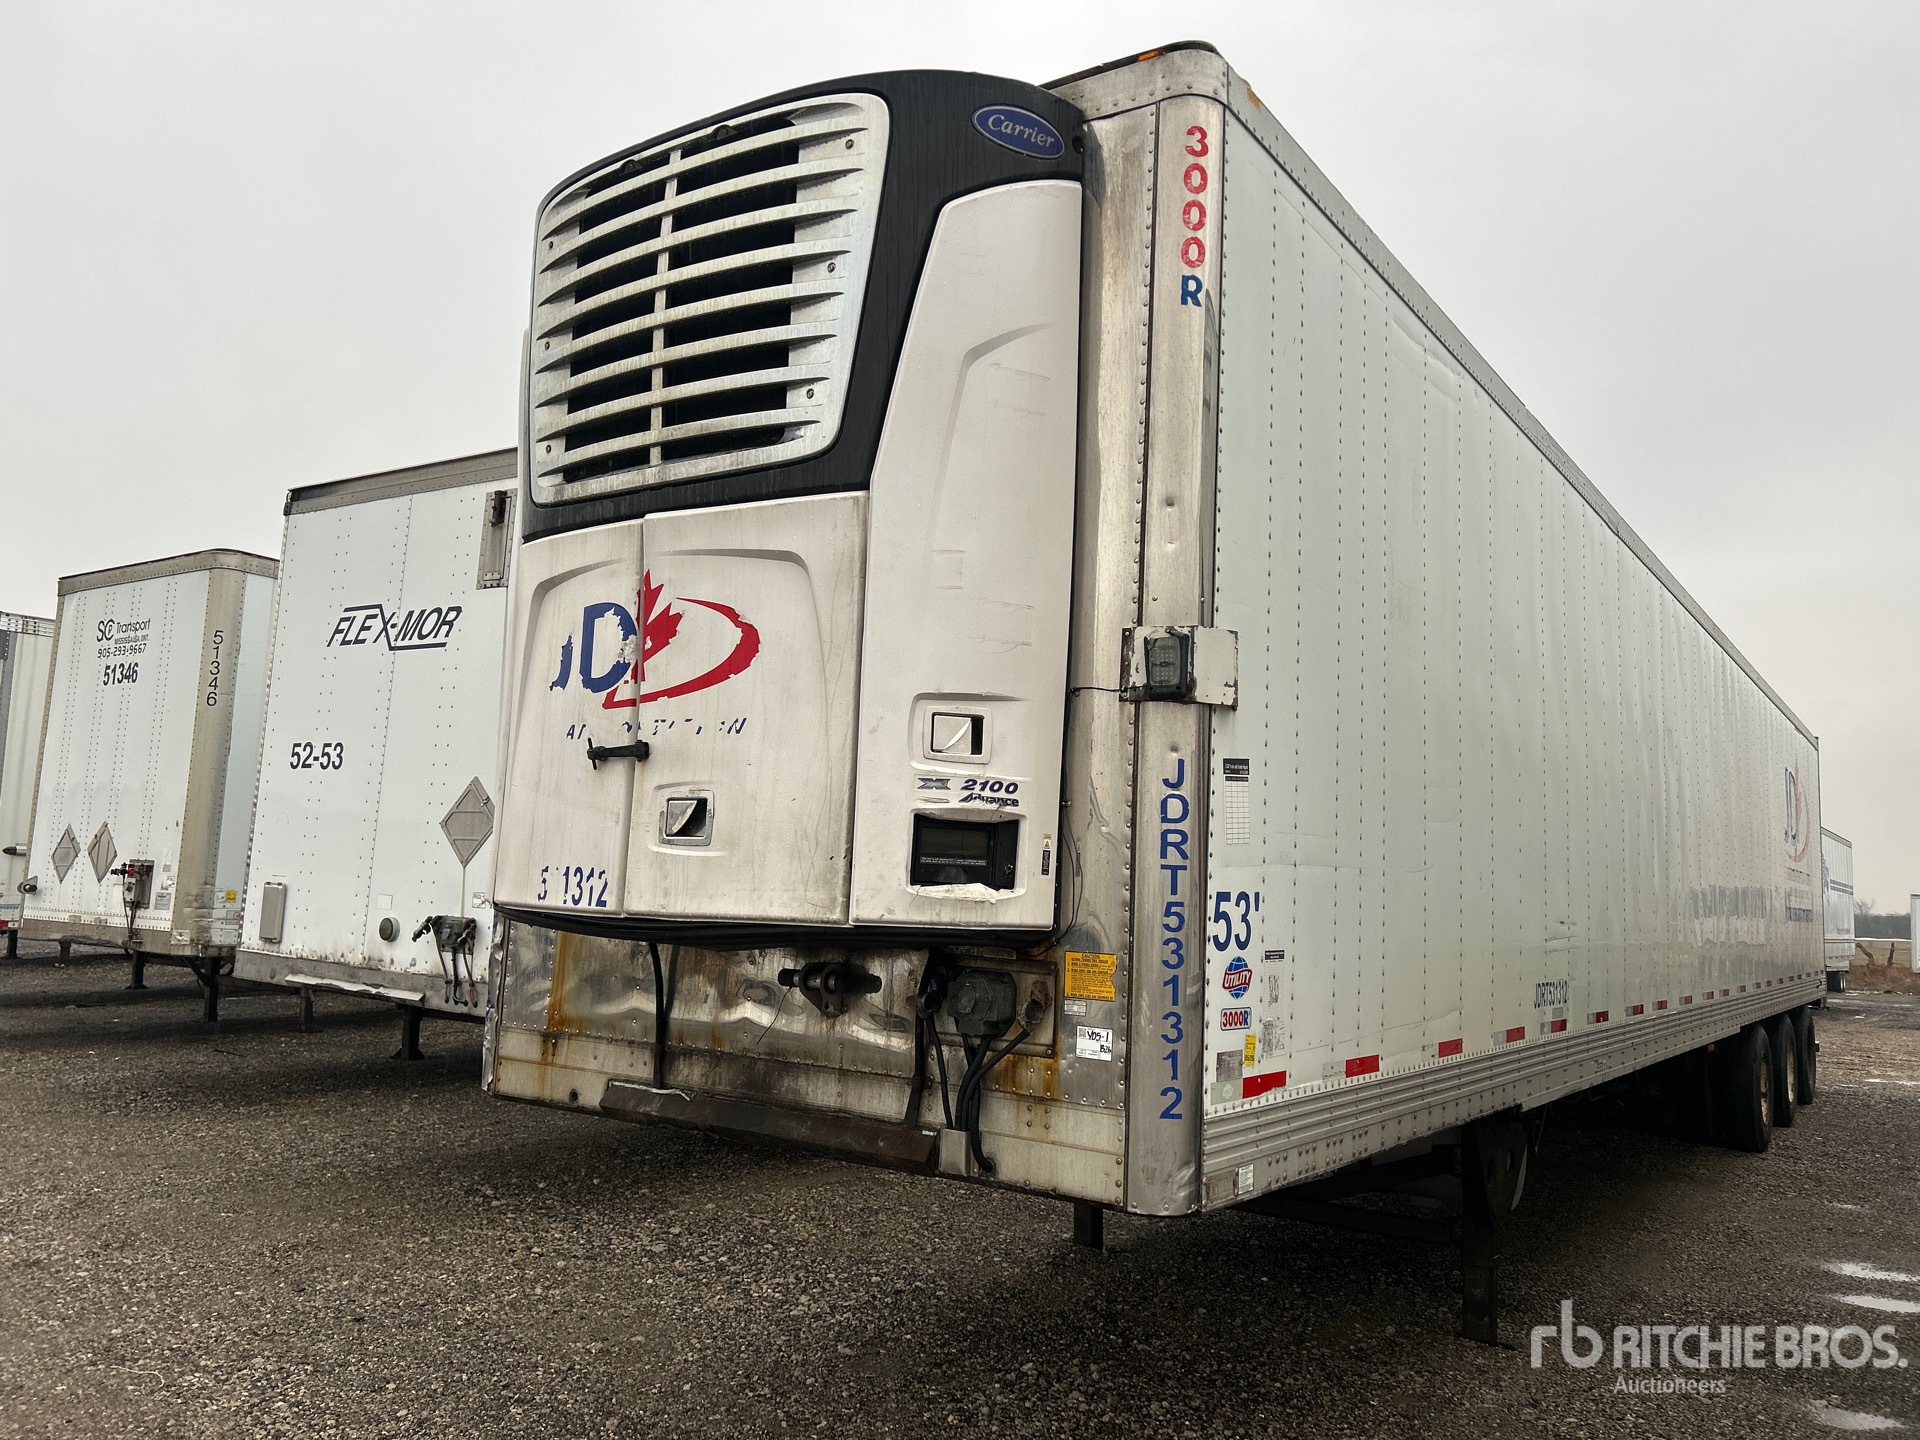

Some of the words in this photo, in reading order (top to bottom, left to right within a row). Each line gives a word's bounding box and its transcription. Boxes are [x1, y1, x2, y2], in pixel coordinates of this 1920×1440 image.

[987, 114, 1055, 148] Carrier
[1180, 125, 1209, 307] 3000R
[116, 617, 151, 635] Transport
[326, 604, 463, 651] FLEX-MOR
[103, 661, 139, 686] 51346
[206, 630, 224, 707] 51346
[290, 742, 344, 770] 52-53
[960, 778, 1019, 795] 2100
[1159, 758, 1190, 1120] JDRT531312
[1224, 971, 1251, 988] UTILITY
[1222, 1010, 1249, 1028] 3000R
